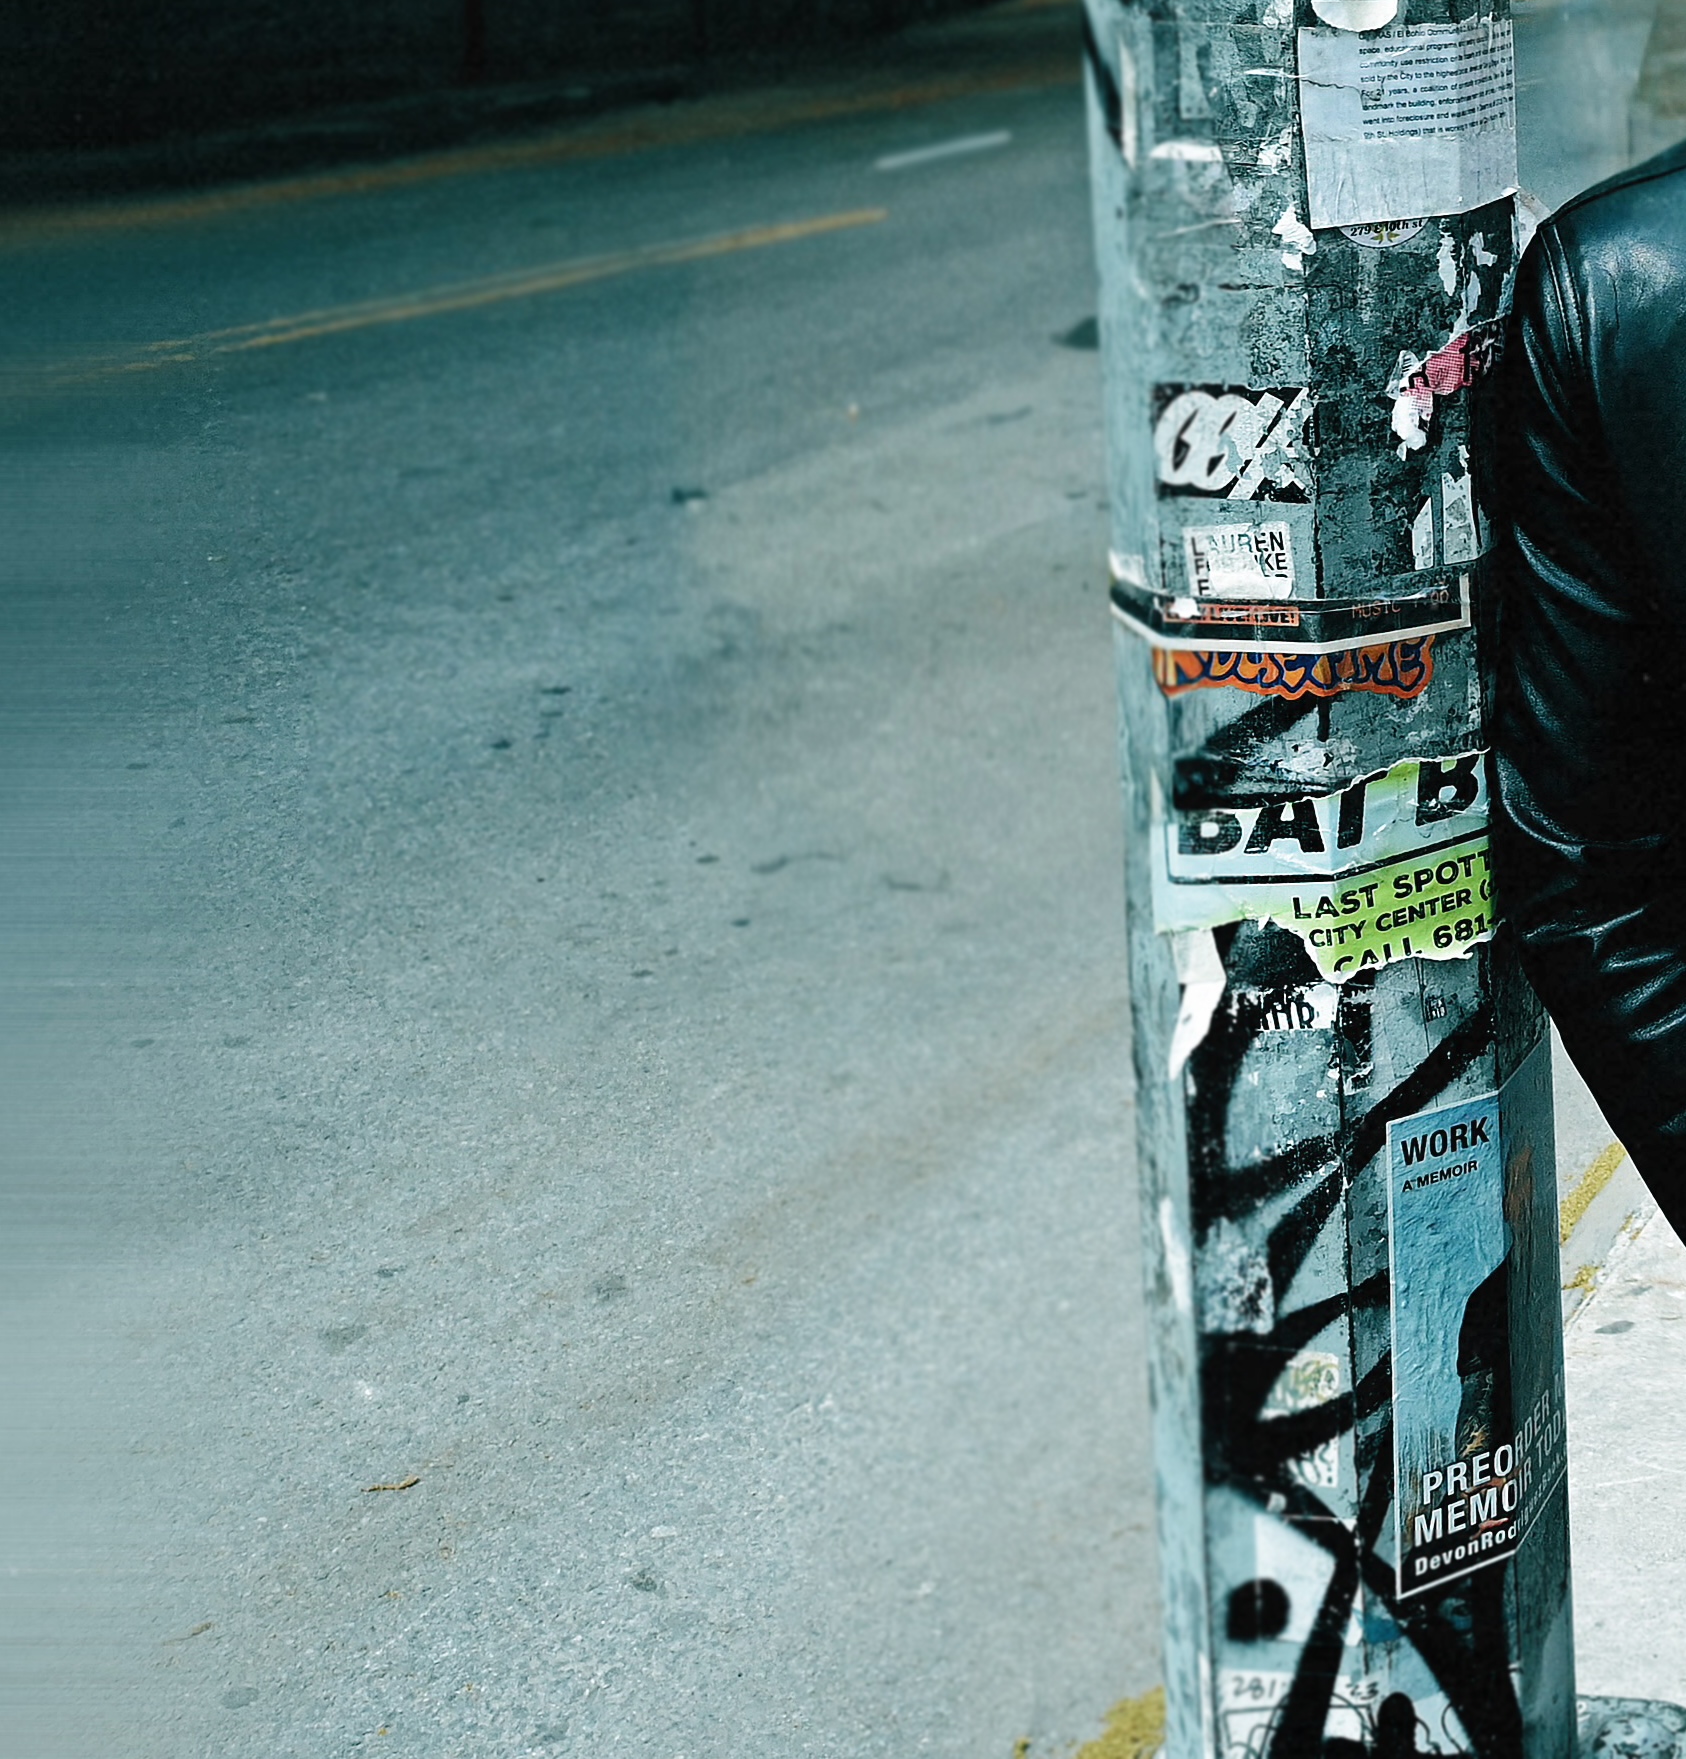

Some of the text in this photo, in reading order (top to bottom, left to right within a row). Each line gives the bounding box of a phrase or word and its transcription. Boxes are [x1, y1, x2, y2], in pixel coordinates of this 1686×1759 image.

[1350, 225, 1371, 237] 279
[1292, 848, 1491, 920] LAST SPOTT
[1308, 919, 1366, 948] CITY
[1375, 888, 1472, 932] CENTER
[1401, 1116, 1489, 1166] WORK
[1402, 1160, 1478, 1193] A MEMOIR
[1423, 1389, 1550, 1505] PREORDER
[1414, 1456, 1533, 1548] MEMOIR
[1536, 1408, 1566, 1468] TOD
